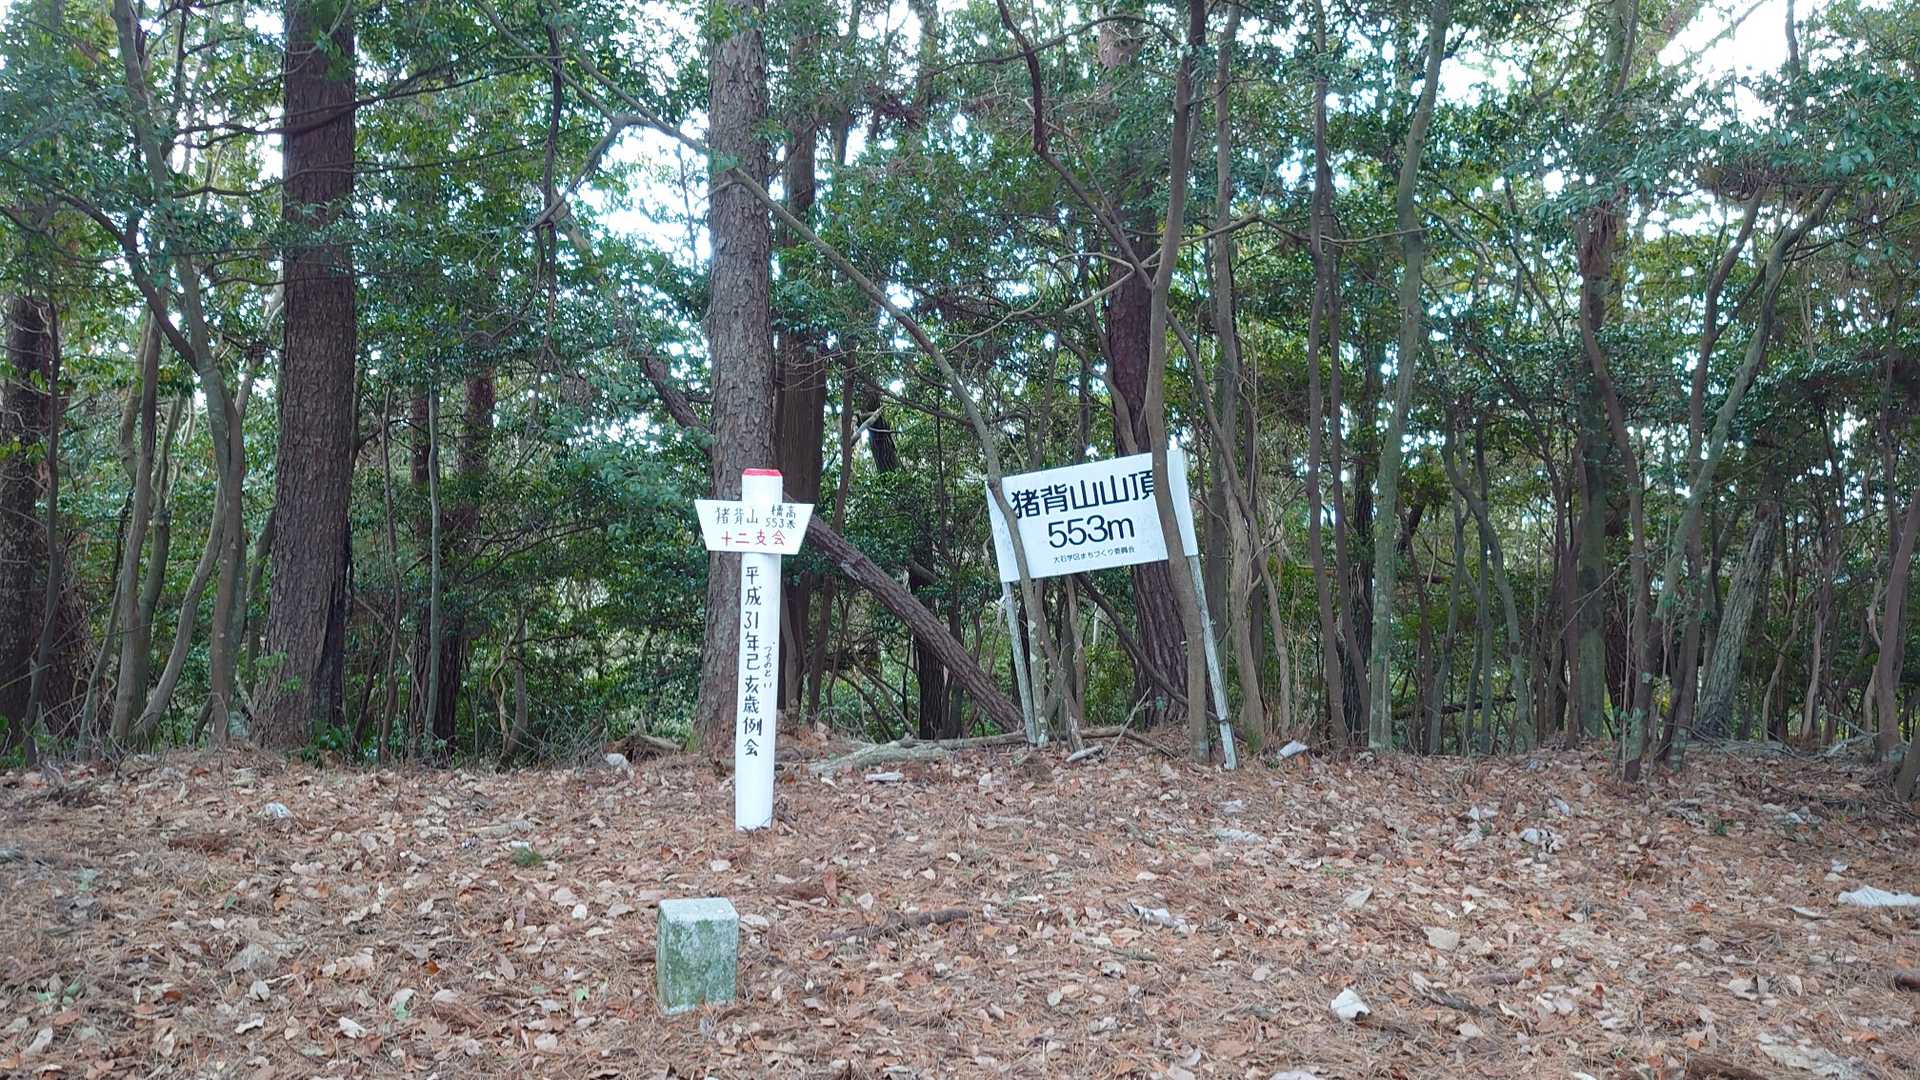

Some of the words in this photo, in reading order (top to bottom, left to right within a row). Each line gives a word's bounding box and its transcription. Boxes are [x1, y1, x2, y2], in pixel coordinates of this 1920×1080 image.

[721, 529, 786, 547] 十二支会
[1048, 515, 1135, 548] 553m
